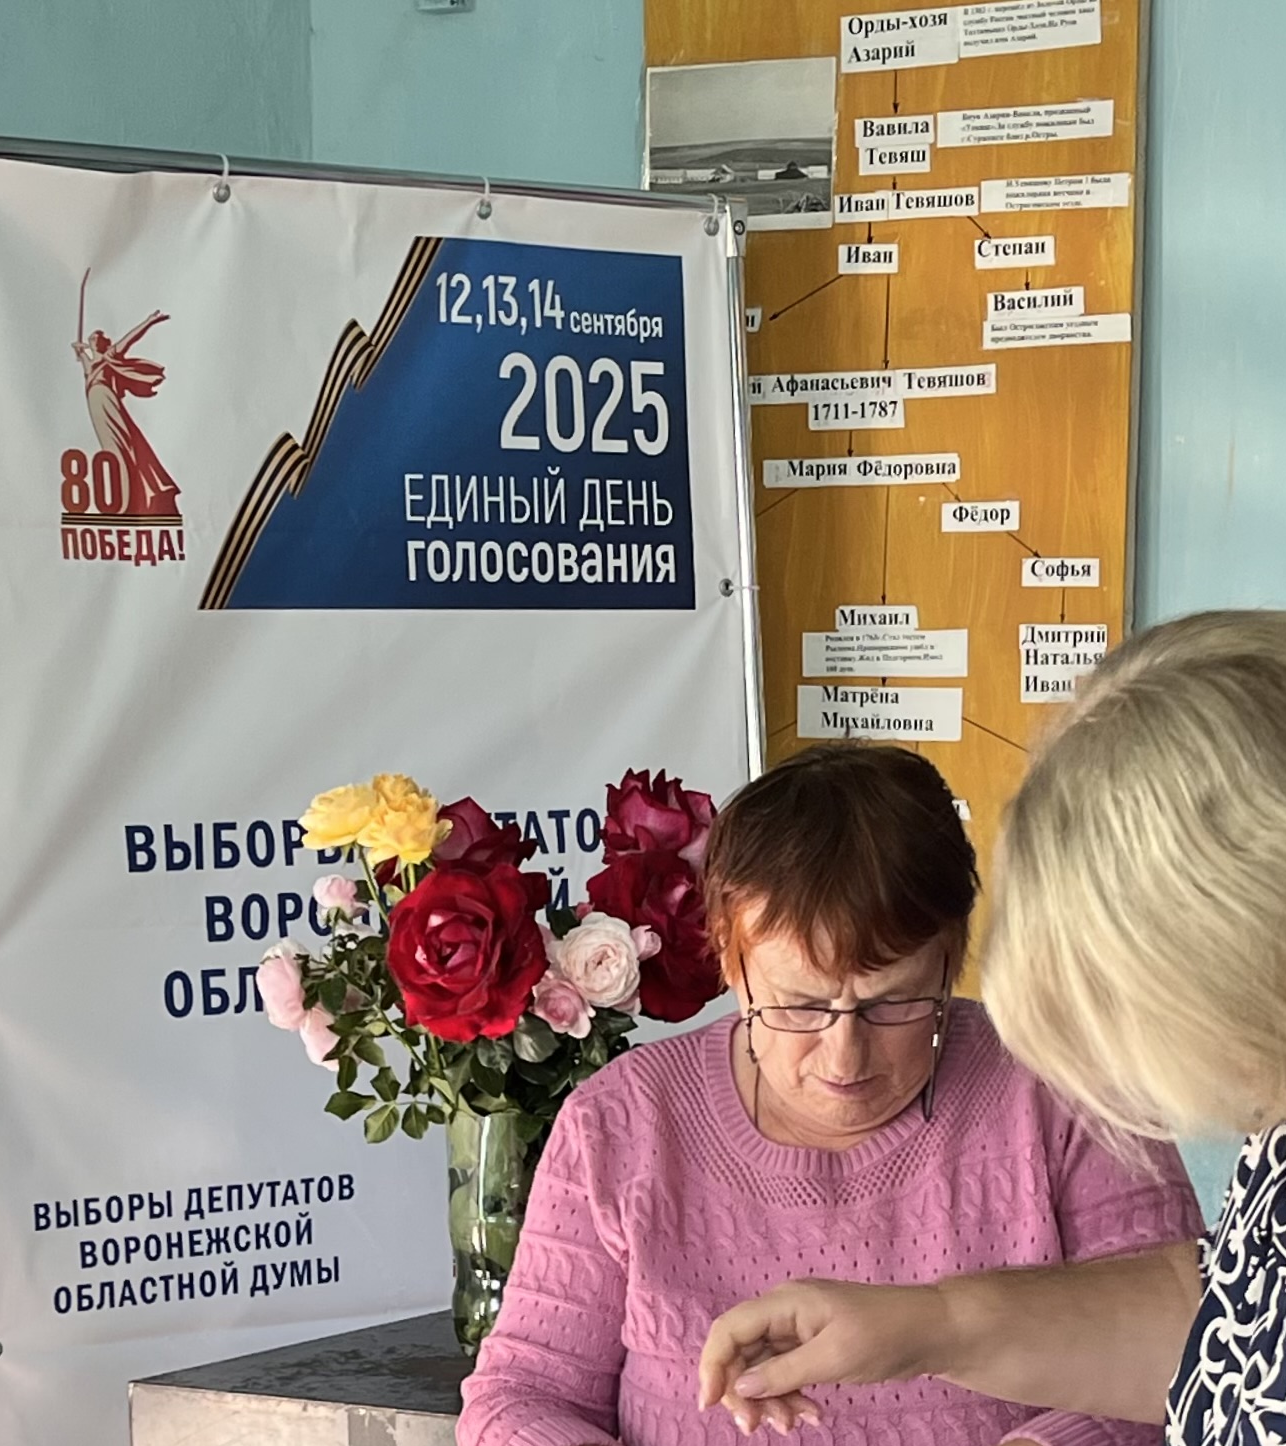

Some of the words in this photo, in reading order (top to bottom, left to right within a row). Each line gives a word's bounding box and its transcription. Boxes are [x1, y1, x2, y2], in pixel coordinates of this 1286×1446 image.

[848, 12, 948, 38] Орды-хозя
[848, 40, 915, 64] Азарий
[863, 119, 930, 138] Вавила
[866, 147, 926, 165] Тевяш
[838, 195, 885, 213] Иван
[892, 192, 975, 210] Тевяшов
[845, 246, 894, 266] Иван
[977, 239, 1046, 258] Степан
[993, 289, 1074, 312] Василий
[570, 308, 663, 343] сентября
[771, 374, 892, 396] Афанасьевич
[903, 371, 987, 390] Тевяшов
[499, 352, 669, 456] 2025
[812, 401, 899, 421] 1711-1787
[787, 459, 848, 480] Мария
[857, 459, 957, 480] Фёдоровна
[61, 448, 124, 514] 80
[404, 466, 565, 529] ЕДИНЫЙ
[579, 479, 673, 532] ДЕНЬ
[952, 505, 1011, 525] Фёдор
[61, 528, 185, 566] ПОБЕДА!
[1031, 559, 1092, 581] Софья
[838, 608, 910, 626] Михаил
[1022, 626, 1106, 648] Дмитрий
[1025, 675, 1073, 693] Иван
[822, 686, 900, 707] Матрёна
[821, 711, 934, 732] Михайловна
[33, 1190, 173, 1231] ВЫБОРЫ
[184, 1173, 356, 1221] ДЕПУТАТОВ
[79, 1211, 313, 1269] ВОРОНЕЖСКОЙ
[53, 1260, 240, 1314] ОБЛАСТНОЙ
[250, 1256, 341, 1298] ДУМЫ
